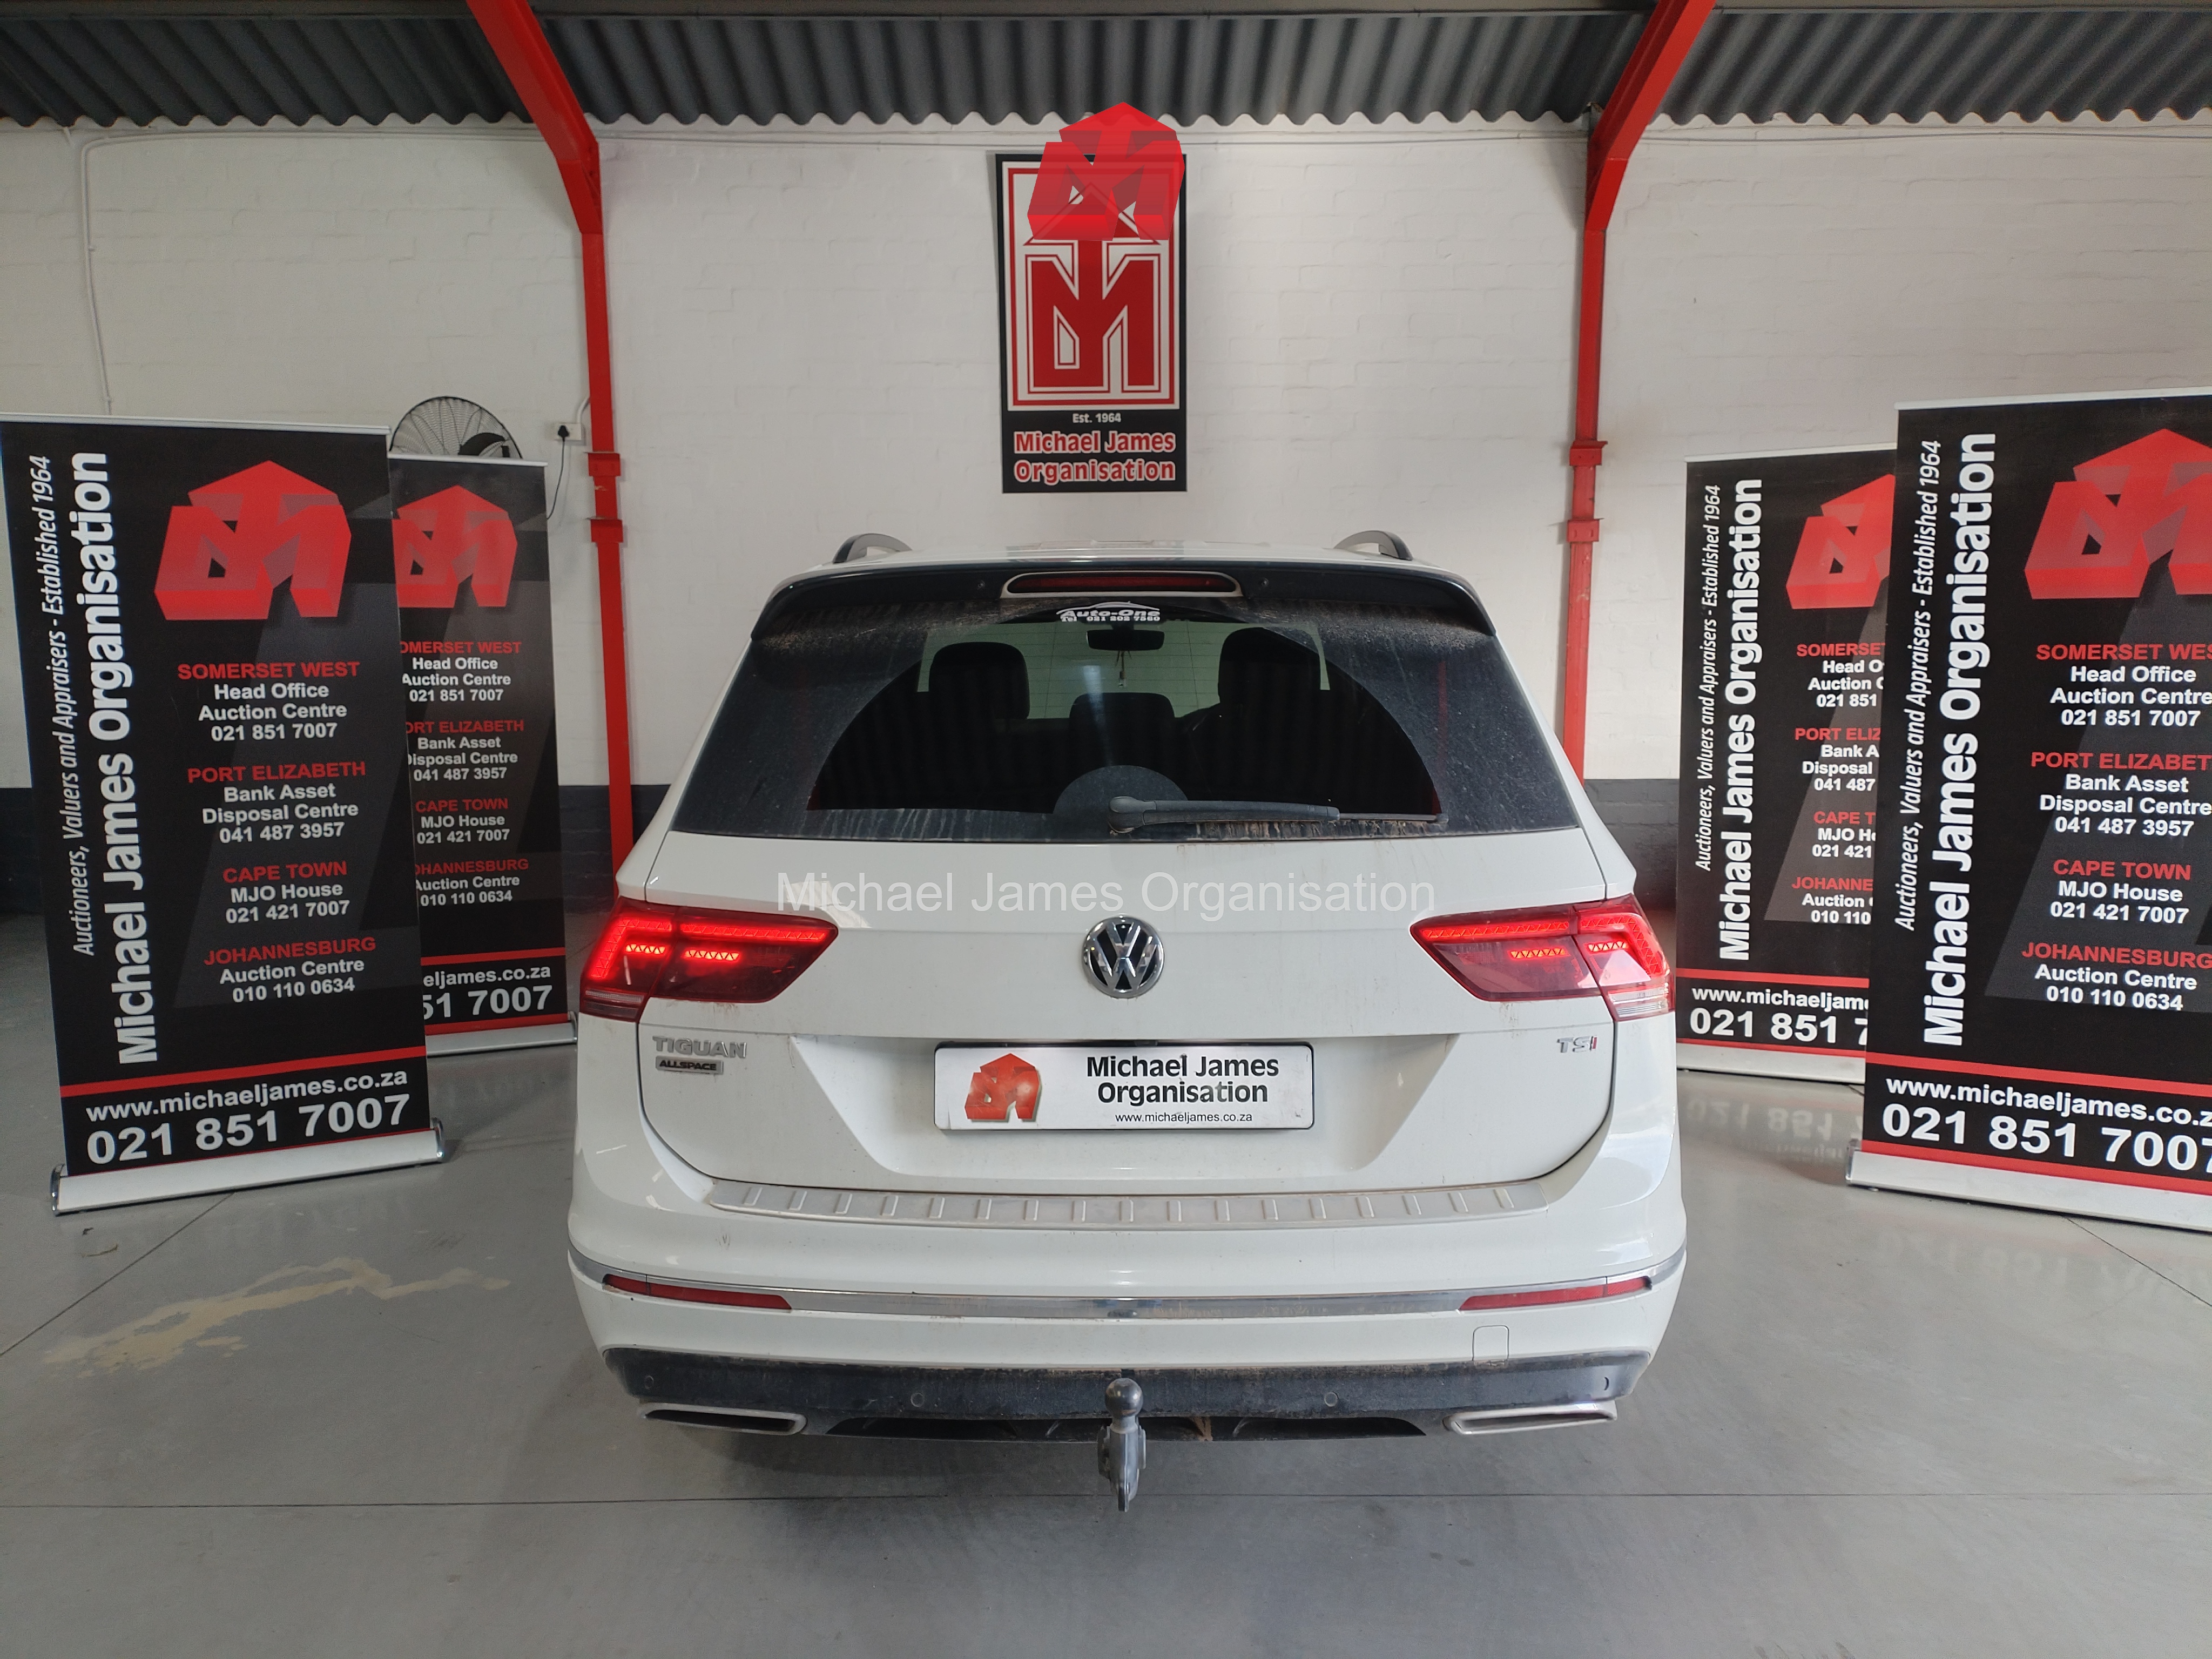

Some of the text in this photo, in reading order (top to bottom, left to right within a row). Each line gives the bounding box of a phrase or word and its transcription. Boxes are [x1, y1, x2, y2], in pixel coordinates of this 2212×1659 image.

[1073, 413, 1121, 423] Est. 1964
[1014, 431, 1175, 454] Michael James
[1014, 458, 1176, 485] Organisation
[477, 642, 522, 653] WEST
[2036, 644, 2163, 660] SOMERSET
[178, 662, 360, 680] SOMERSET WEST
[413, 657, 498, 669] Head Office
[1823, 660, 1864, 673] Head
[463, 673, 511, 686] Centre
[1695, 485, 1720, 871] Auctioneers, Valuers and Appraisers Established 1964
[2071, 666, 2196, 682] Head Office
[215, 683, 329, 700] Head Office
[1808, 677, 1871, 690] Auction
[1894, 440, 1941, 931] Auctioneers, Valuers and Appraisers Established 1964
[409, 689, 503, 702] 021 851 7007
[1816, 694, 1877, 707] 021 851
[2050, 687, 2212, 704] Auction Centre
[29, 456, 94, 956] Auctioneers, Valuers and Appraisers Established 1964
[199, 704, 347, 721] Auction Centre
[439, 720, 524, 733] ELIZABETH
[1719, 480, 1762, 960] Michael James Organisation
[2061, 710, 2201, 726] 021 851 7007
[211, 723, 338, 741] 021 851 7007
[1795, 728, 1842, 740] PORT
[1924, 434, 1995, 1046] Michael James Organisation
[418, 736, 501, 749] Bank Asset
[1821, 745, 1863, 757] Bank
[70, 453, 157, 1064] Michael James Organisation
[470, 752, 518, 764] Centre
[2031, 752, 2093, 768] PORT
[187, 762, 366, 783] PORT ELIZABETH
[414, 767, 507, 781] 041 487 3957
[1802, 761, 1872, 777] Disposal
[1815, 778, 1876, 791] 041 487
[2066, 773, 2188, 792] Bank Asset
[225, 784, 335, 802] Bank Asset
[415, 798, 508, 812] CAPE TOWN
[2040, 794, 2212, 815] Disposal Centre
[202, 804, 358, 825] Disposal Centre
[421, 815, 505, 828] MJO House
[1814, 811, 1860, 824] CAPE
[219, 822, 345, 844] 041 487 3957
[417, 828, 510, 844] 021 421 7007
[1818, 828, 1854, 841] MJO
[2055, 817, 2194, 837] 041 487 3957
[222, 861, 347, 884] CAPE TOWN
[2053, 860, 2191, 880] CAPE TOWN
[473, 875, 520, 888] Centre
[231, 883, 343, 903] MJO House
[1802, 893, 1864, 907] Auction
[2059, 881, 2183, 902] MJO House
[226, 900, 350, 923] 021 421 7007
[2051, 902, 2189, 923] 021 421 7007
[204, 938, 376, 966] JOHANNESBURG
[2022, 942, 2212, 969] JOHANNESBURG
[219, 960, 365, 984] Auction Centre
[2035, 964, 2197, 990] Auction Centre
[233, 977, 355, 1003] 010 110 0634
[2047, 986, 2183, 1011] 010 110 0634
[468, 985, 552, 1015] 7007
[1690, 1008, 1753, 1037] 021
[1771, 1013, 1836, 1043] 851
[652, 1036, 747, 1058] TIGUAN
[1557, 1036, 1597, 1053] TSI
[659, 1060, 717, 1070] ALLSPACE
[1087, 1054, 1279, 1077] Michael James
[86, 1070, 407, 1122] www.michaeljames.co.za
[1098, 1081, 1269, 1107] Organisation
[1115, 1112, 1252, 1124] www.michaeljames.co.za
[87, 1094, 410, 1164] 021 851 7007
[1882, 1103, 2076, 1157] 021 851
